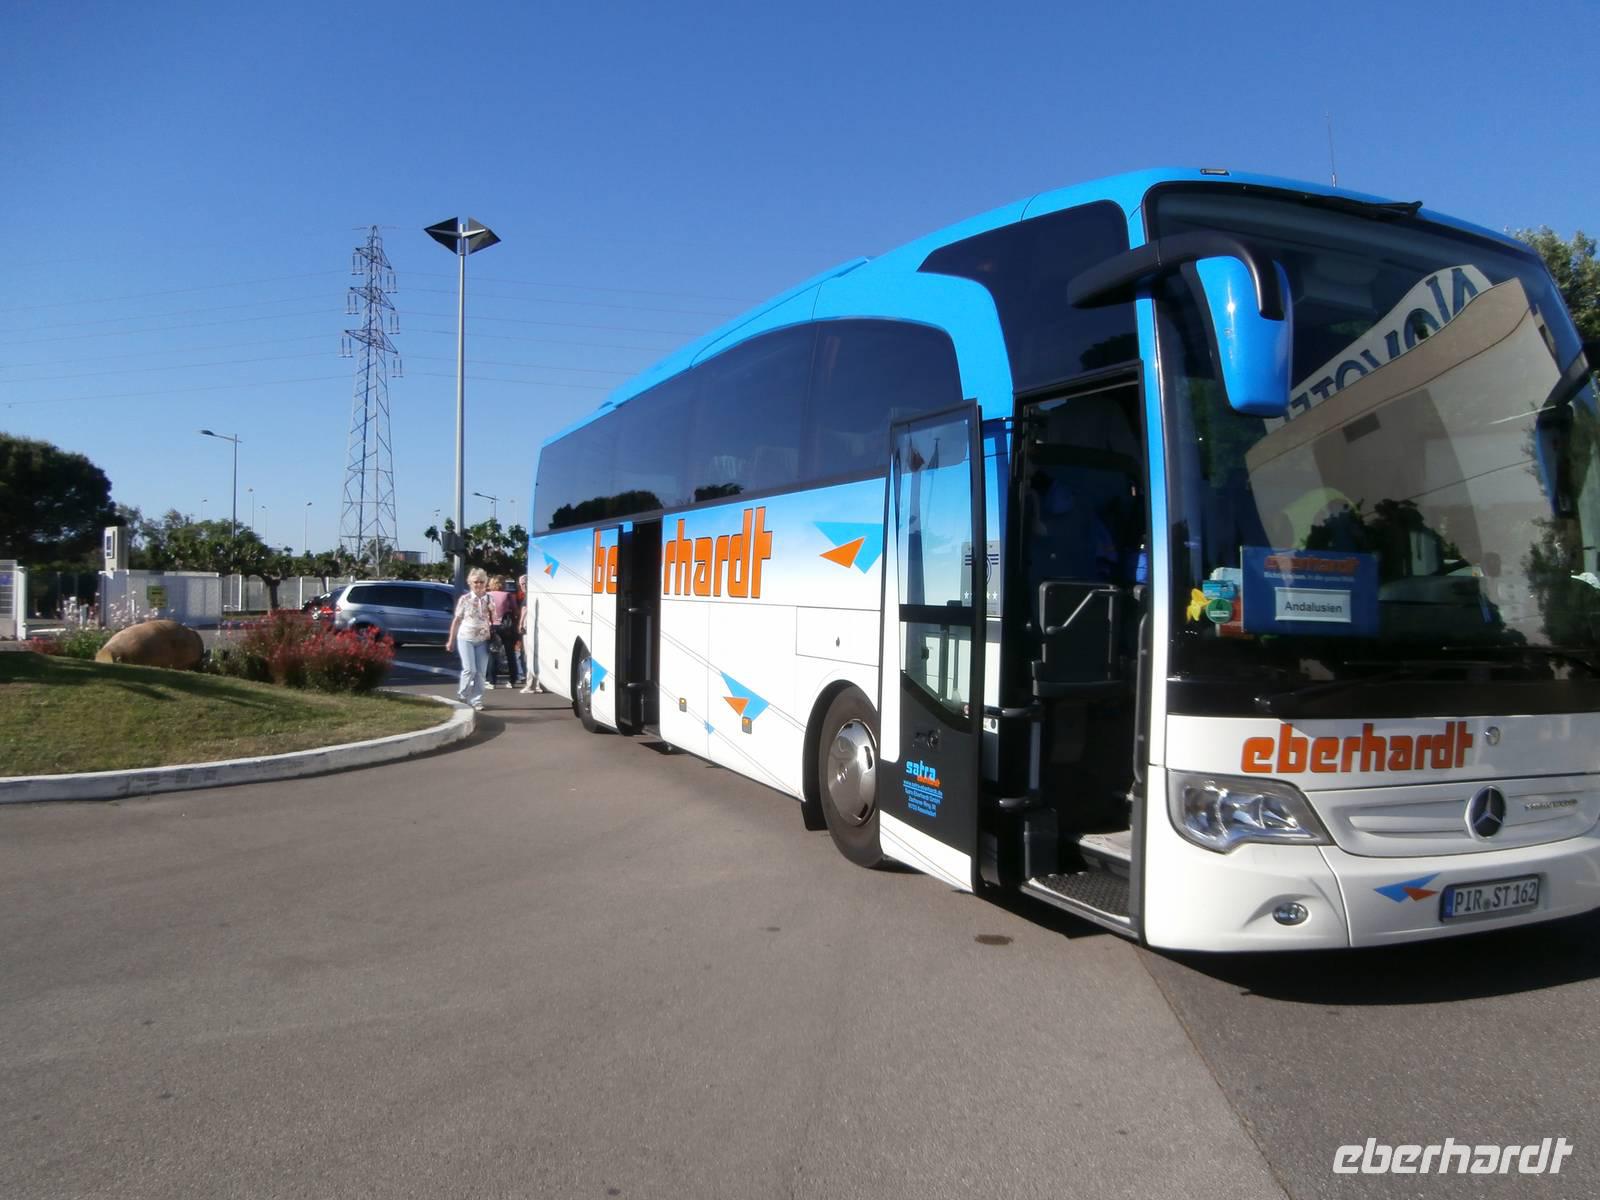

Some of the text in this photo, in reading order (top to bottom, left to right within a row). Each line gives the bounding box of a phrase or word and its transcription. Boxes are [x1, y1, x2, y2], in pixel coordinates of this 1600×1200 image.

[1284, 601, 1343, 614] Andalusien
[1241, 720, 1474, 774] eberhardt
[1455, 888, 1483, 912] PIR
